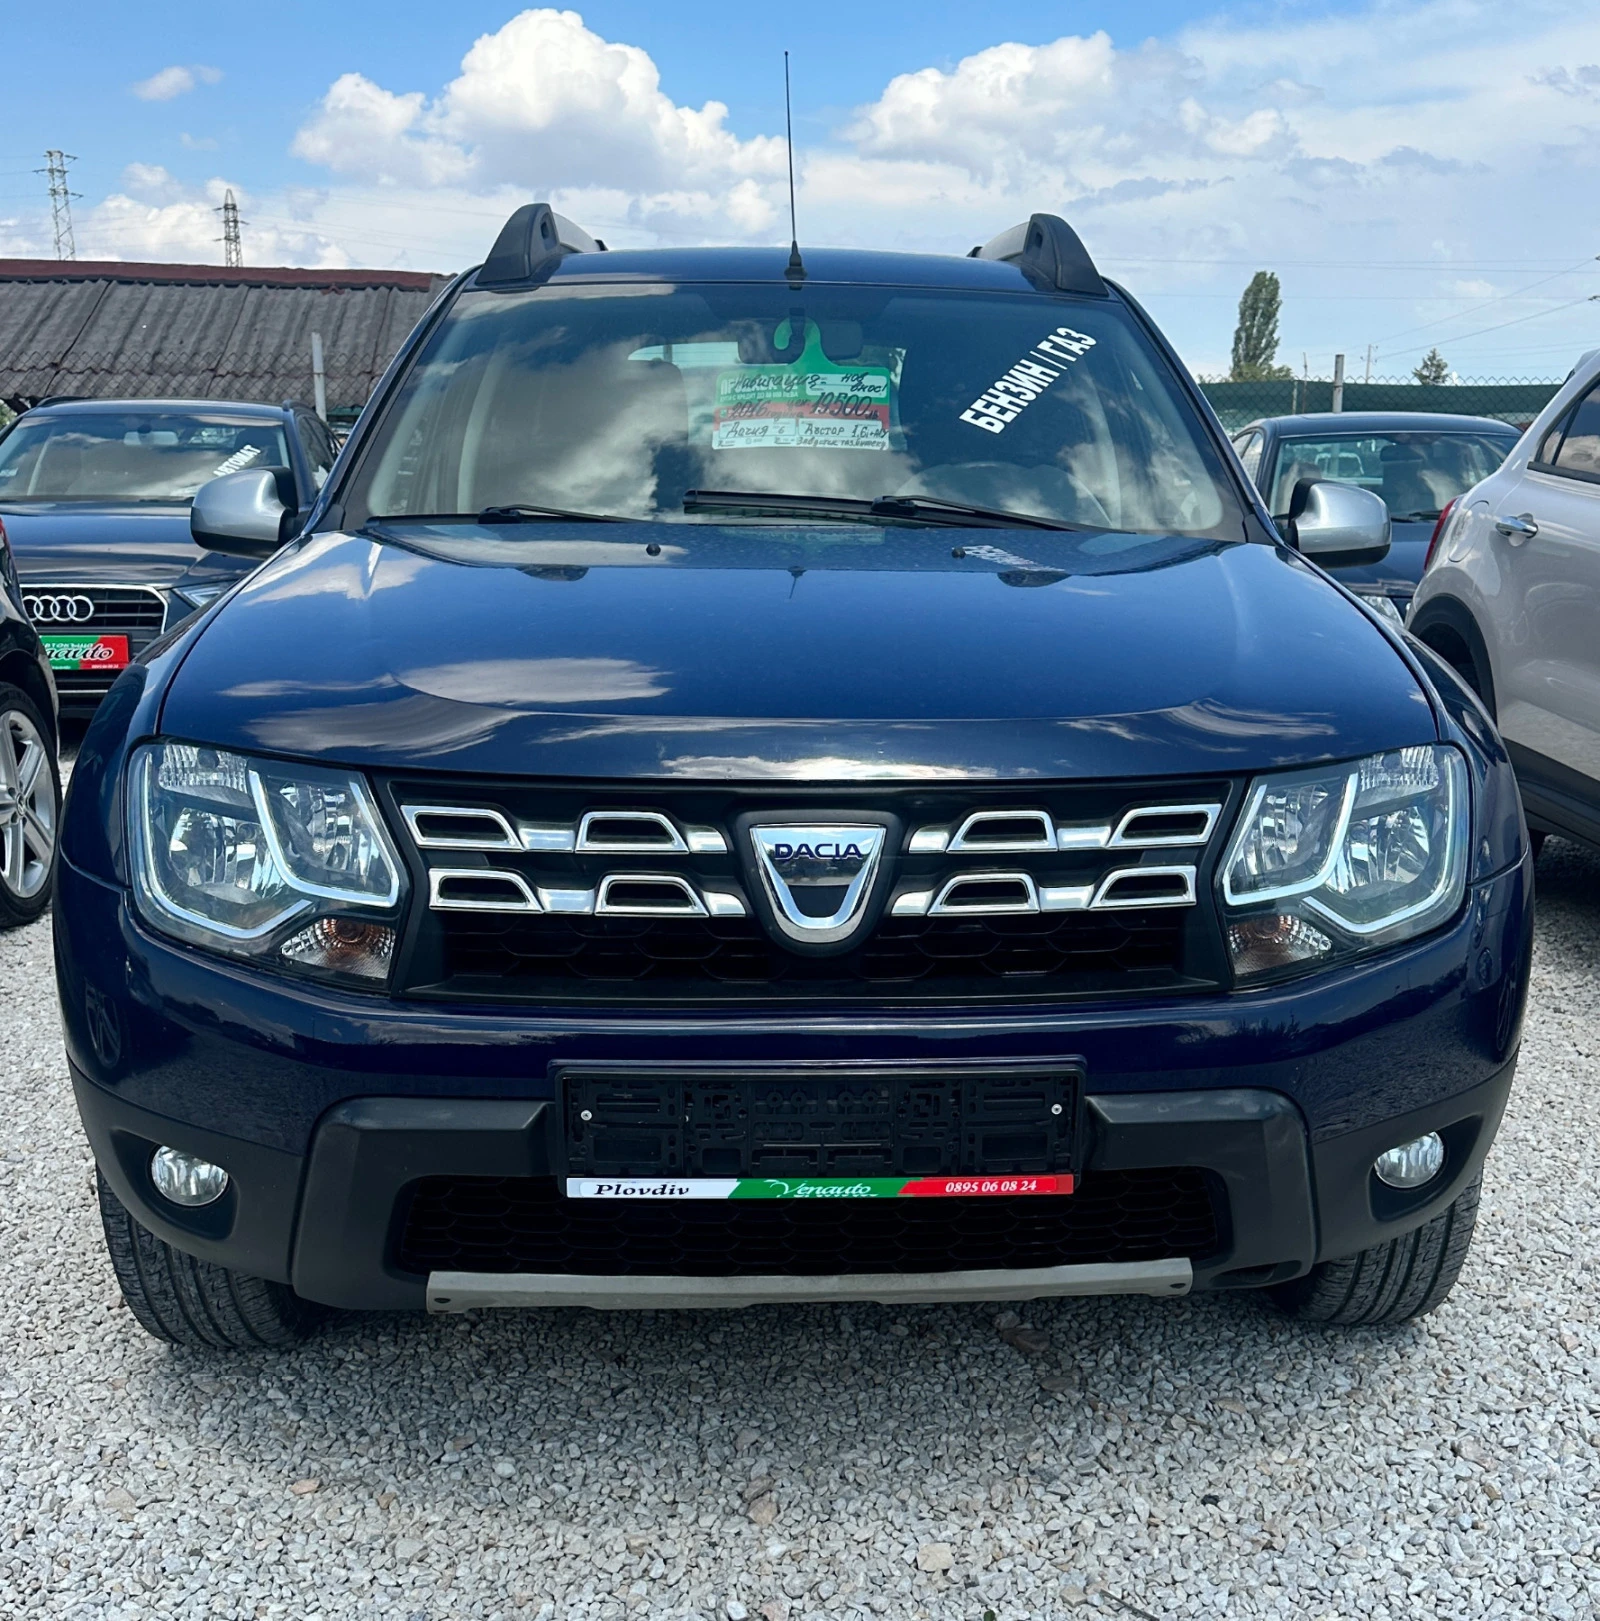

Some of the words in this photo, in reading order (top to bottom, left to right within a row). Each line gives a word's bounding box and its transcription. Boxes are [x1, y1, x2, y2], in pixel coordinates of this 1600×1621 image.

[959, 359, 1060, 434] БЕНЗИН
[1037, 327, 1097, 361] ГАЗ
[775, 843, 863, 860] DACIA
[593, 1184, 690, 1195] Plovdiv
[763, 1179, 873, 1197] Venauto
[945, 1182, 979, 1193] 0895
[981, 1182, 998, 1192] 06
[1000, 1181, 1018, 1191] 08
[1019, 1180, 1037, 1191] 24
